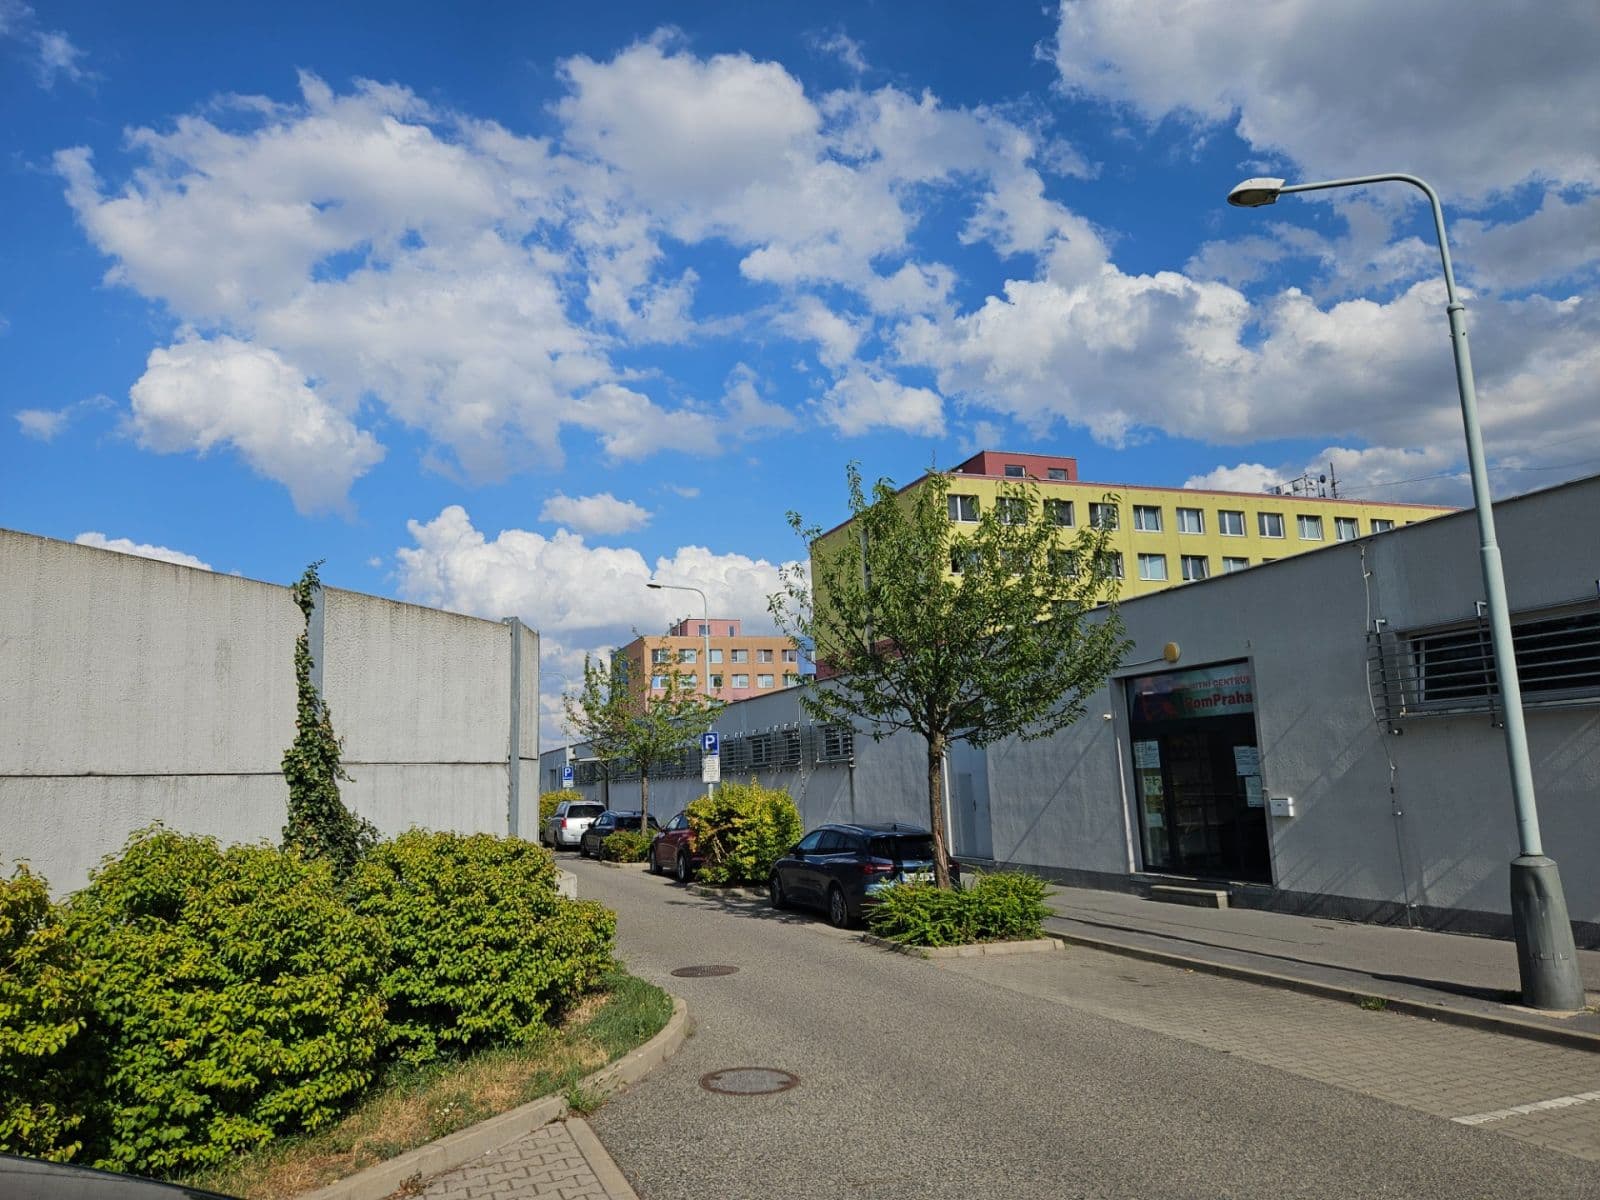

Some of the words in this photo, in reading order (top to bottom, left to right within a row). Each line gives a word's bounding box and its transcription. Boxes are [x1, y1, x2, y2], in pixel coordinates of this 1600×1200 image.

[1184, 690, 1253, 708] RomPraha
[705, 734, 715, 749] P
[564, 767, 572, 777] P
